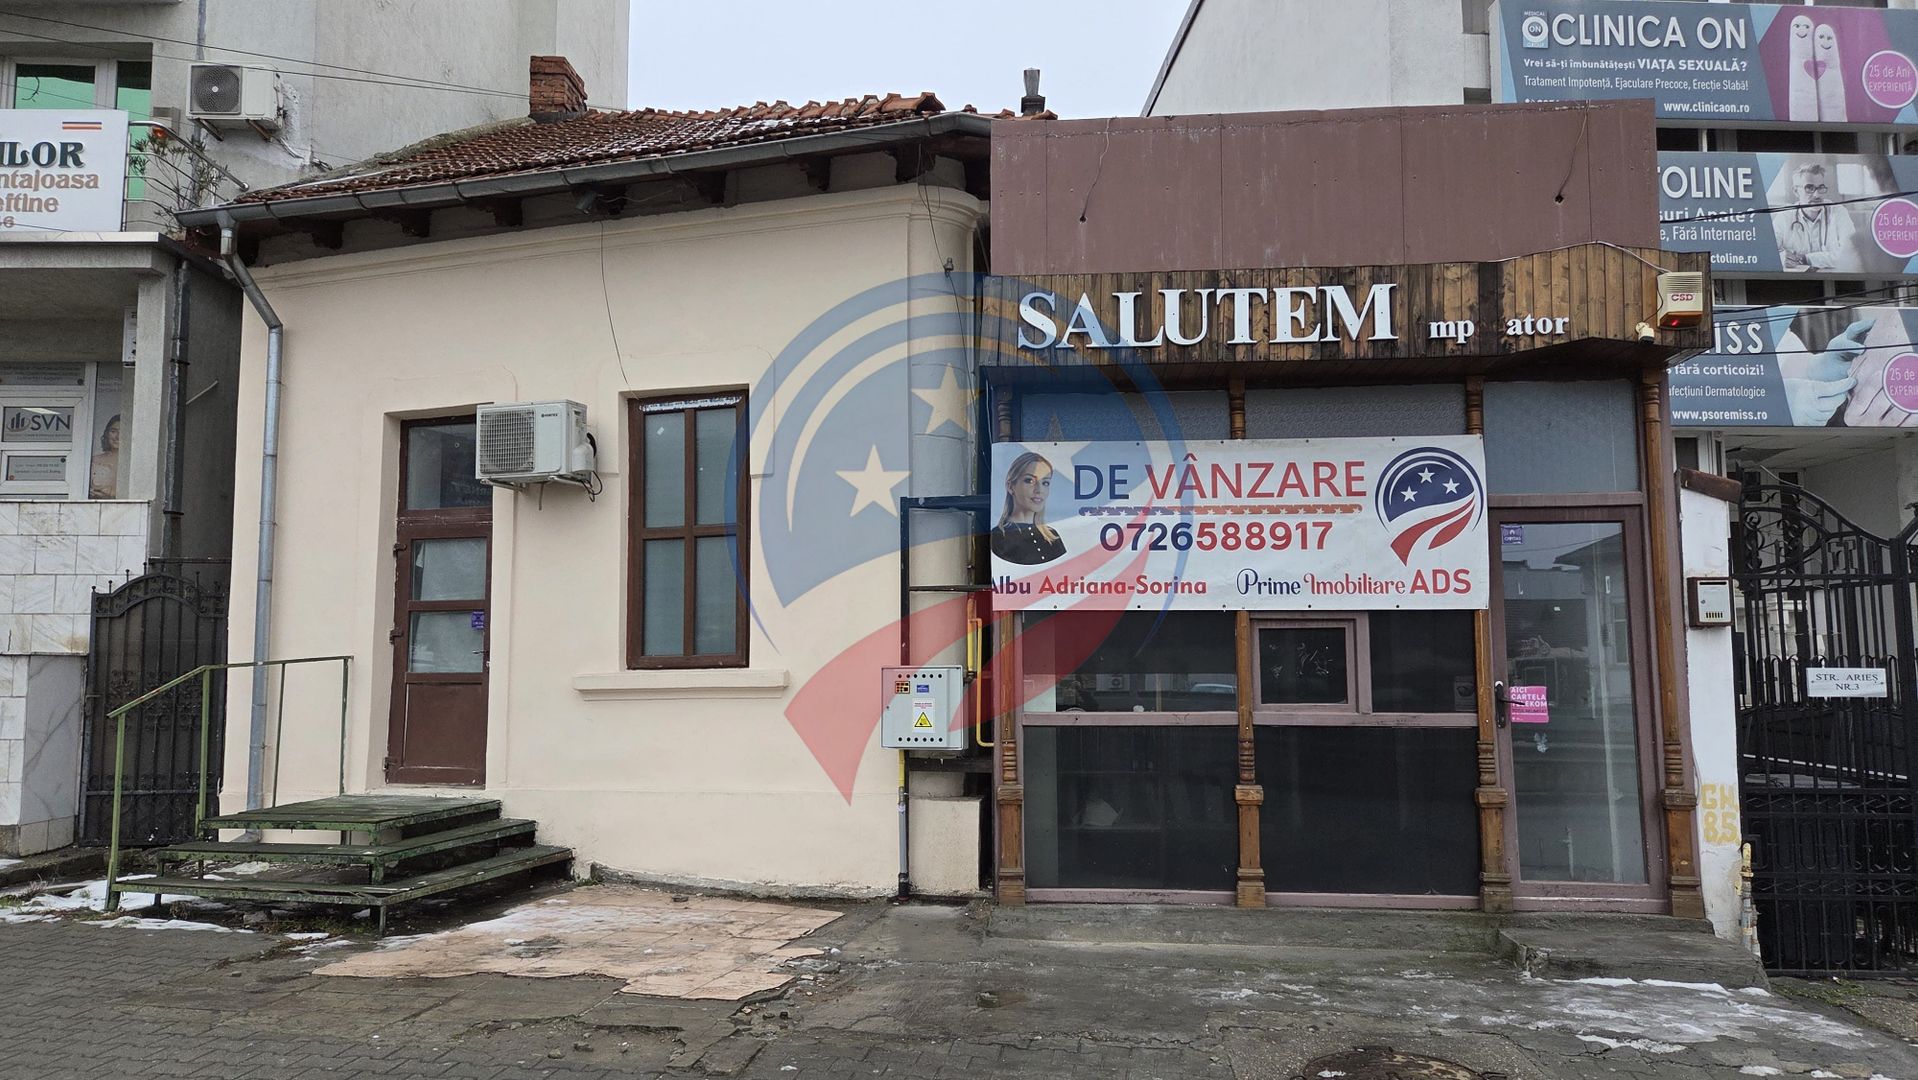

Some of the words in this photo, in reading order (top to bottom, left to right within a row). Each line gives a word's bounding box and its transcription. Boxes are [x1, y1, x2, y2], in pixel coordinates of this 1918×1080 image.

[1528, 25, 1542, 33] ON
[1552, 13, 1687, 49] CLINICA
[1697, 17, 1747, 49] ON
[1523, 59, 1544, 68] Vrei
[1679, 58, 1748, 72] SEXUALĂ?
[1869, 65, 1880, 78] 25
[1882, 65, 1894, 78] de
[1524, 75, 1567, 87] Tratament
[1615, 77, 1653, 90] Ejaculare
[1655, 78, 1691, 90] Precoce,
[1693, 79, 1721, 92] Erecție
[1723, 80, 1749, 91] Slabă!
[1664, 101, 1750, 113] www.clinicaon.ro
[1657, 165, 1753, 199] OLINE
[1879, 213, 1890, 226] 25
[1891, 213, 1903, 226] de
[1673, 226, 1697, 240] Fără
[1701, 227, 1756, 240] Internare!
[1710, 253, 1758, 264] ctoline.ro
[1671, 293, 1694, 302] CSD
[1018, 283, 1399, 349] SALUTEM
[1428, 318, 1475, 344] mp
[1507, 312, 1569, 337] ator
[1704, 322, 1763, 354] ISS
[1674, 363, 1700, 375] fără
[1703, 364, 1765, 376] corticoizi!
[1890, 367, 1902, 381] 25
[1903, 368, 1916, 381] de
[1705, 386, 1766, 400] Dermatologice
[1672, 408, 1768, 422] www.psoremiss.ro
[31, 414, 72, 431] SVN
[1074, 464, 1130, 500] DE
[1145, 453, 1367, 500] VÂNZARE
[1100, 521, 1333, 552] 0726588917
[1038, 574, 1208, 595] Adriana-Sorina
[1237, 568, 1301, 596] Prime
[1303, 572, 1406, 595] Imobiliare
[1409, 568, 1472, 595] ADS
[1816, 673, 1840, 681] STR.
[1836, 683, 1860, 691] NR.3
[1511, 693, 1547, 701] CARTELA
